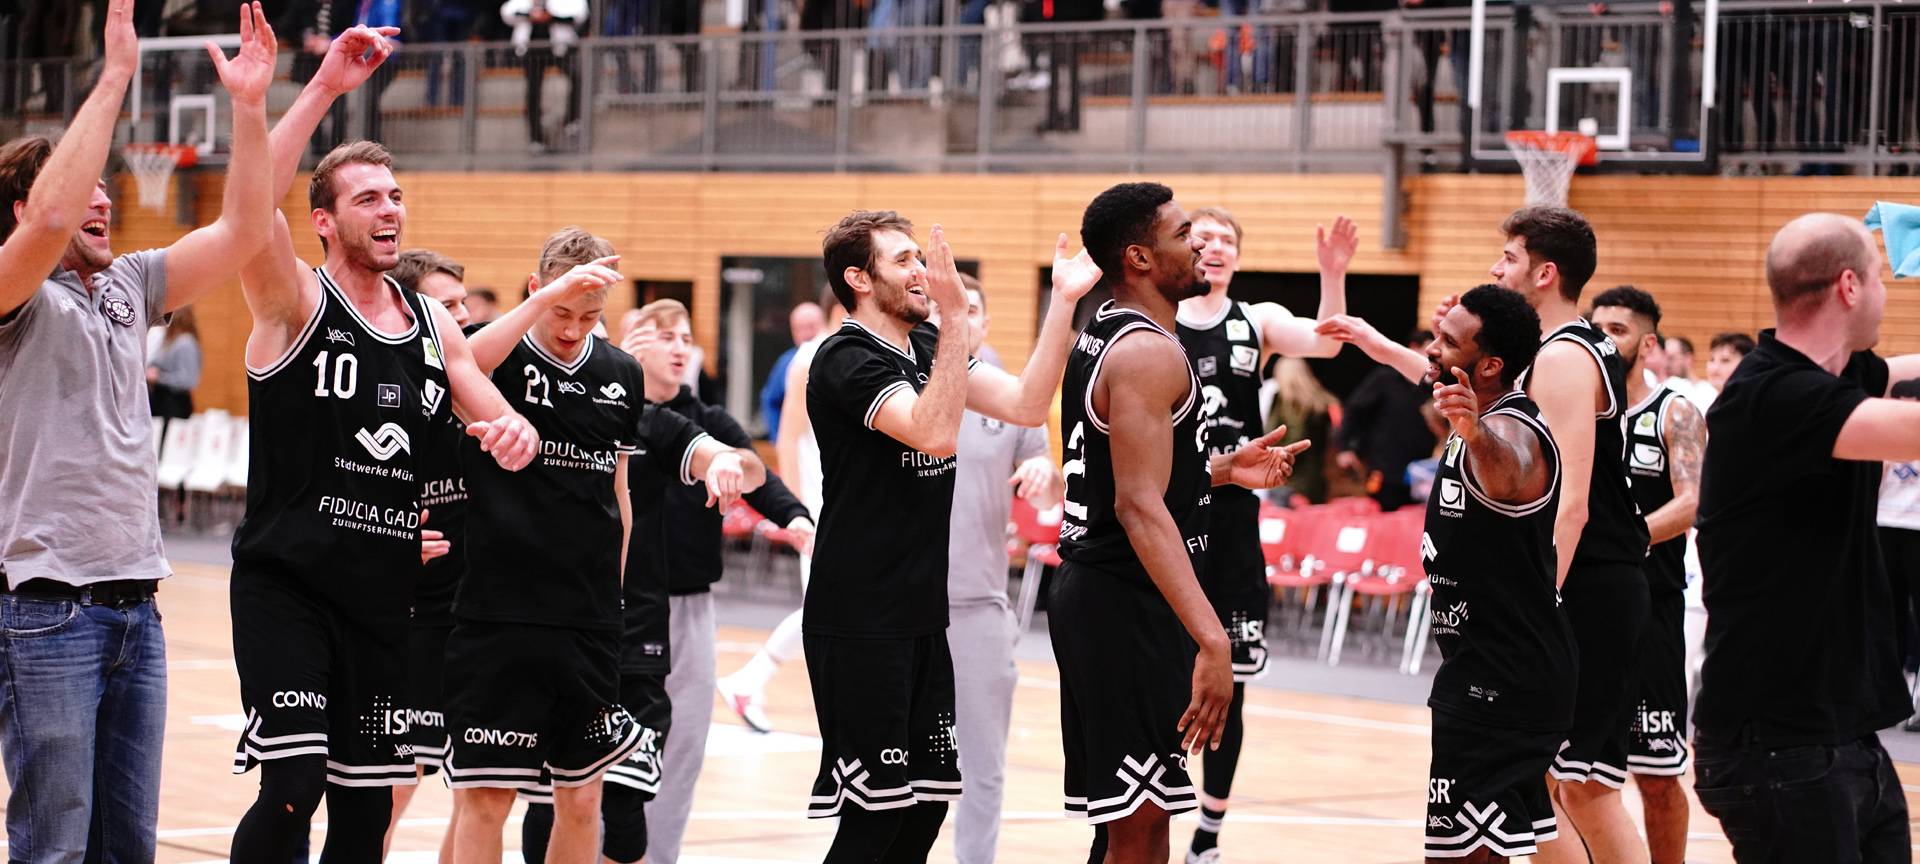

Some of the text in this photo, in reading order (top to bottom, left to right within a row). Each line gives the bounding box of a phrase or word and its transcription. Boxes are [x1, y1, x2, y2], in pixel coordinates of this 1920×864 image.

[313, 350, 358, 399] 10
[523, 363, 554, 408] 21
[318, 495, 419, 529] FIDUCIA GAD
[464, 727, 538, 748] CONVOTIS
